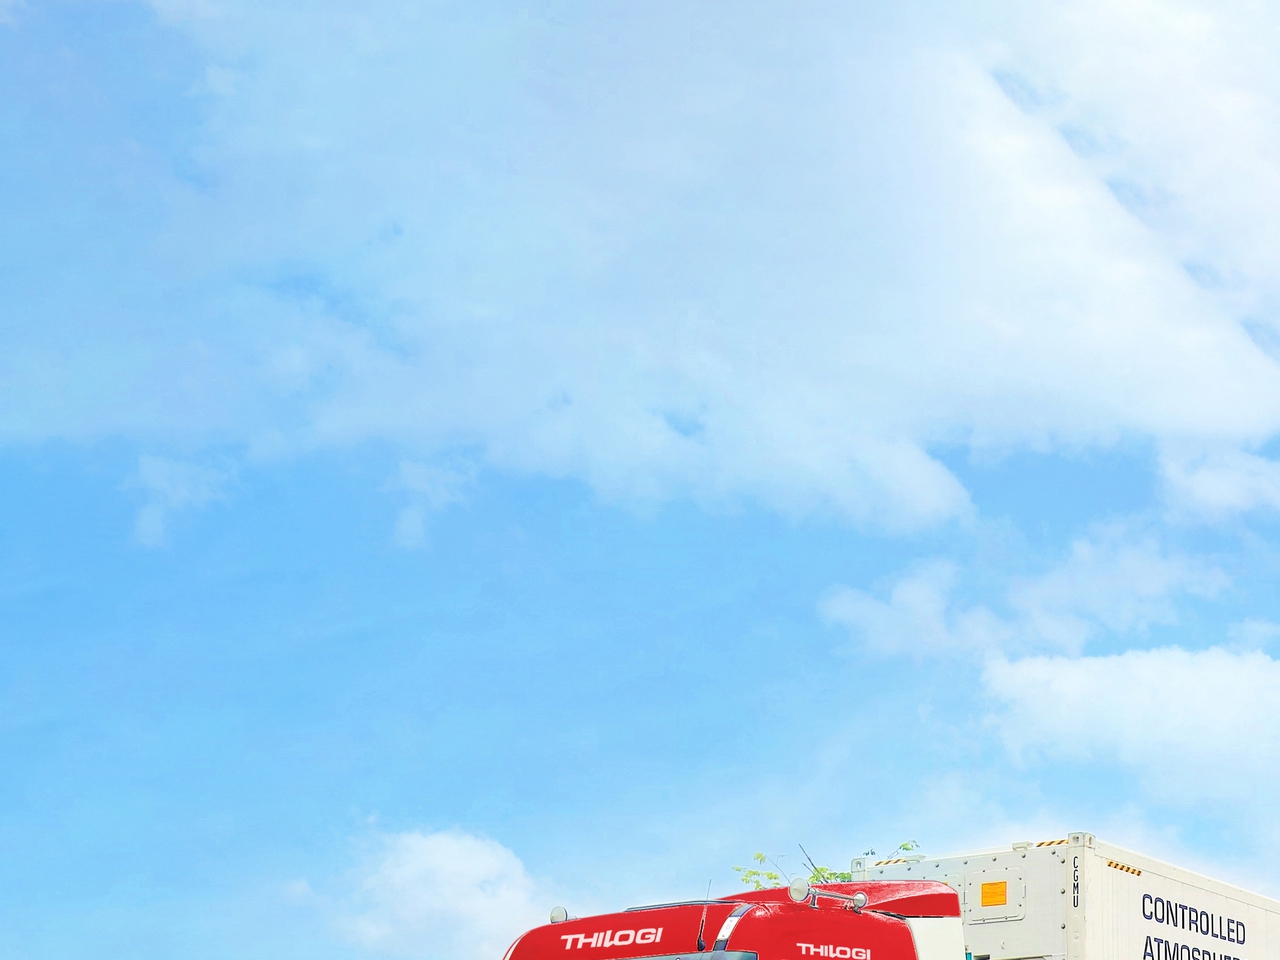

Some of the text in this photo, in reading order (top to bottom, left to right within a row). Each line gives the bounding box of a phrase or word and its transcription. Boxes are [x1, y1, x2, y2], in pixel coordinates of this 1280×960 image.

[1142, 893, 1246, 945] CONTROLLED
[560, 927, 664, 950] THILOGI
[796, 942, 871, 960] THILOGI
